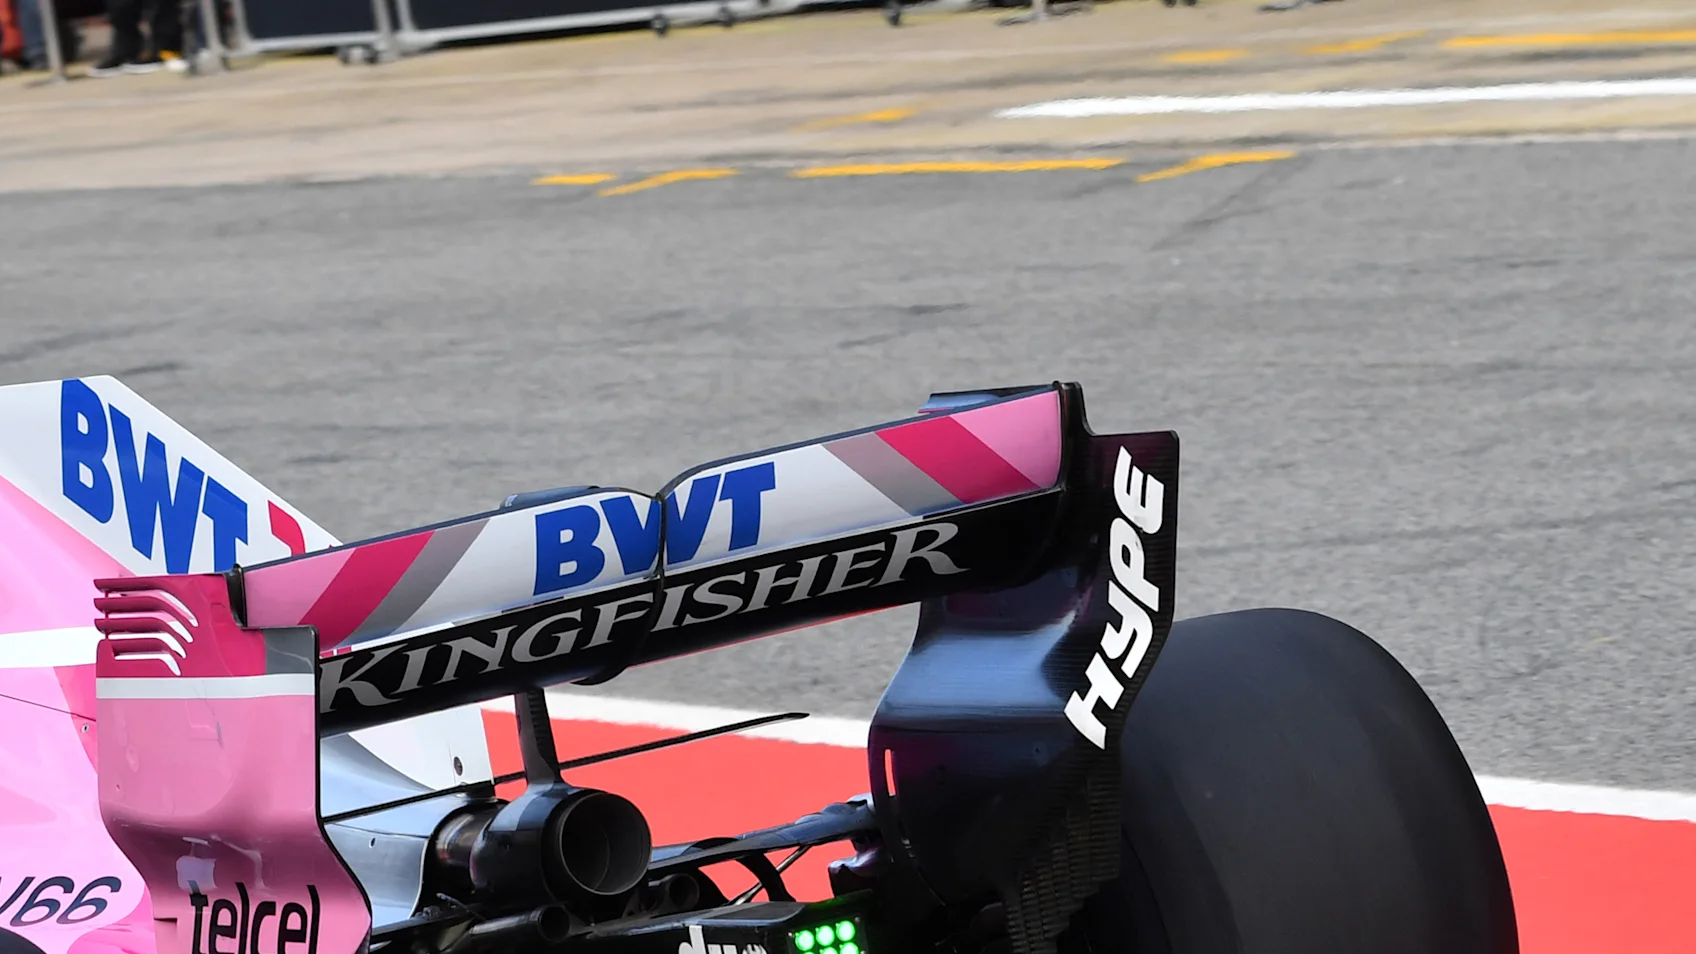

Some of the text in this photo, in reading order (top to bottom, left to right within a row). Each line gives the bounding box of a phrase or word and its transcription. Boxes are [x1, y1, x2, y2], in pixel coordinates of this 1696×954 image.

[60, 378, 249, 575] BWT
[534, 461, 777, 598] BWT
[318, 522, 971, 714] KINGFISHER
[1064, 445, 1165, 750] HYPE
